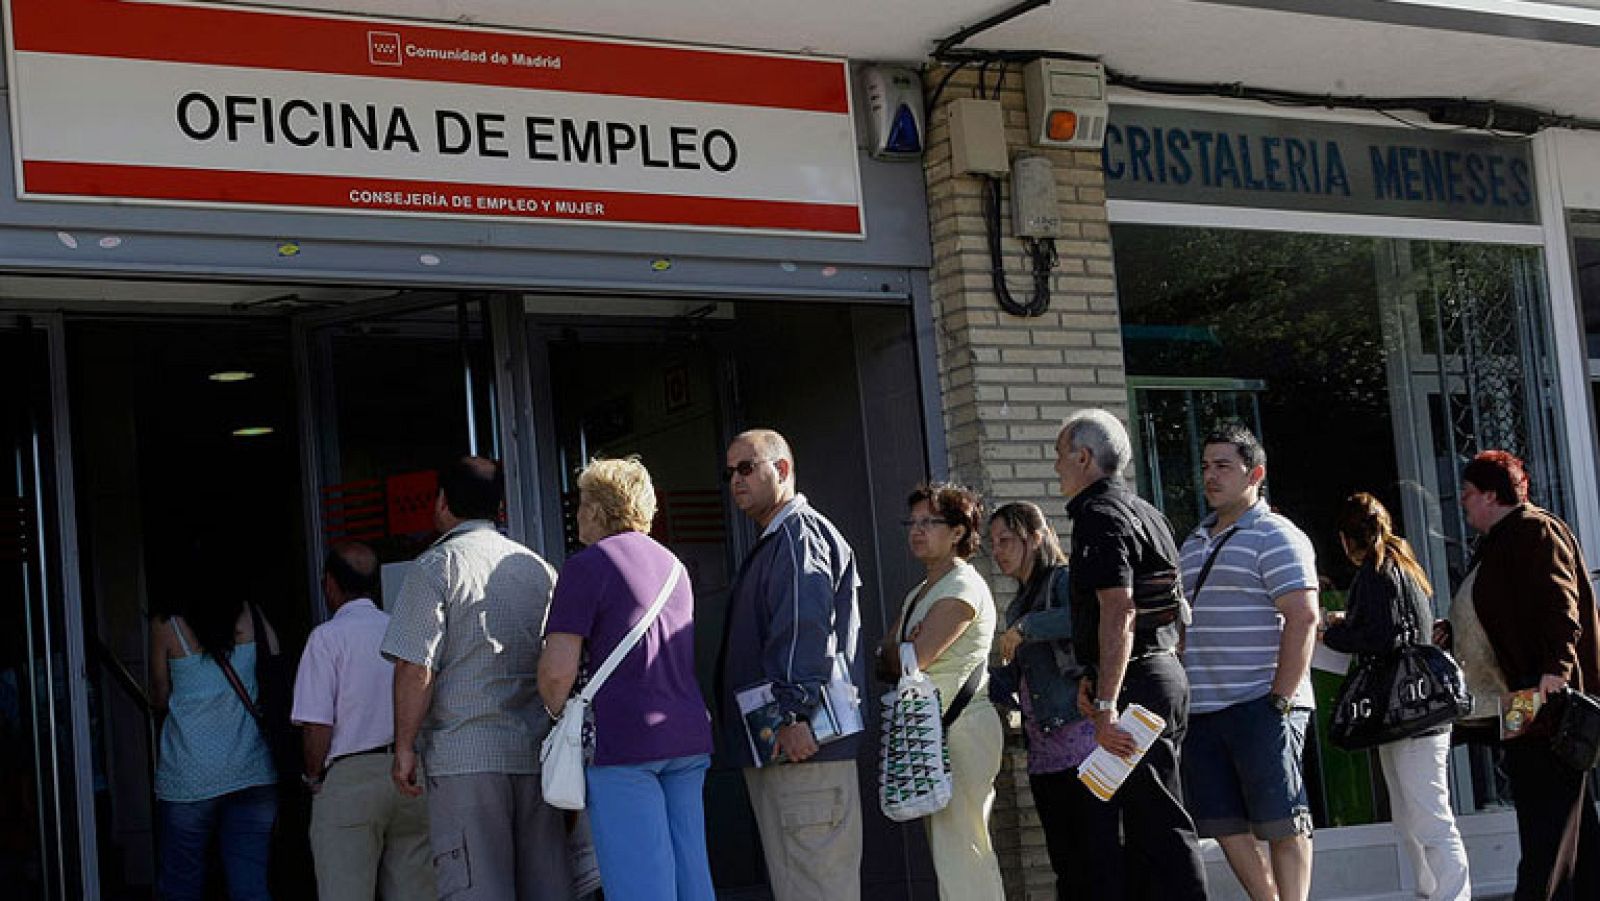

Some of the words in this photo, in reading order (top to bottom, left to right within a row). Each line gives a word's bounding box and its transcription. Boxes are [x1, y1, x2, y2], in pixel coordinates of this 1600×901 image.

[405, 44, 486, 64] Comunidad
[491, 52, 508, 65] de
[512, 53, 561, 69] Madrid
[177, 92, 419, 152] OFICINA
[435, 110, 508, 158] DE
[526, 116, 737, 172] EMPLEO
[1103, 125, 1350, 196] CRISTALERIA
[1370, 145, 1531, 206] MENESES
[349, 189, 448, 206] CONSEJERÍA
[452, 195, 471, 208] DE
[476, 197, 537, 212] EMPLEO
[541, 200, 550, 212] Y
[555, 202, 604, 215] MUJER
